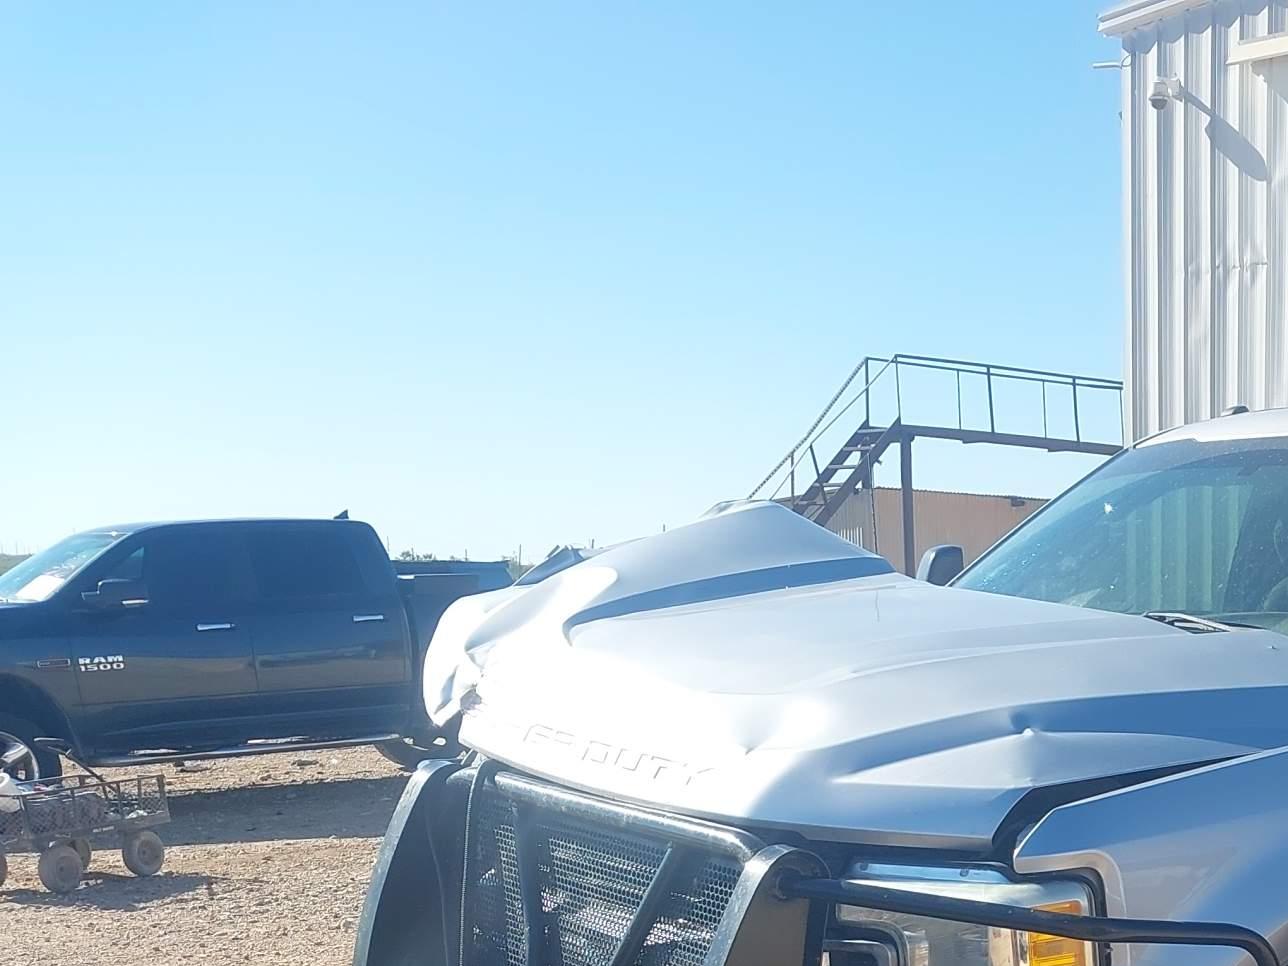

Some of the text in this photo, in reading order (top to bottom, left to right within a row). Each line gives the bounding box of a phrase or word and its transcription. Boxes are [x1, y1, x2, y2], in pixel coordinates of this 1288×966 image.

[79, 655, 124, 664] RAM
[80, 663, 124, 671] 1500
[581, 740, 716, 786] DUTY
